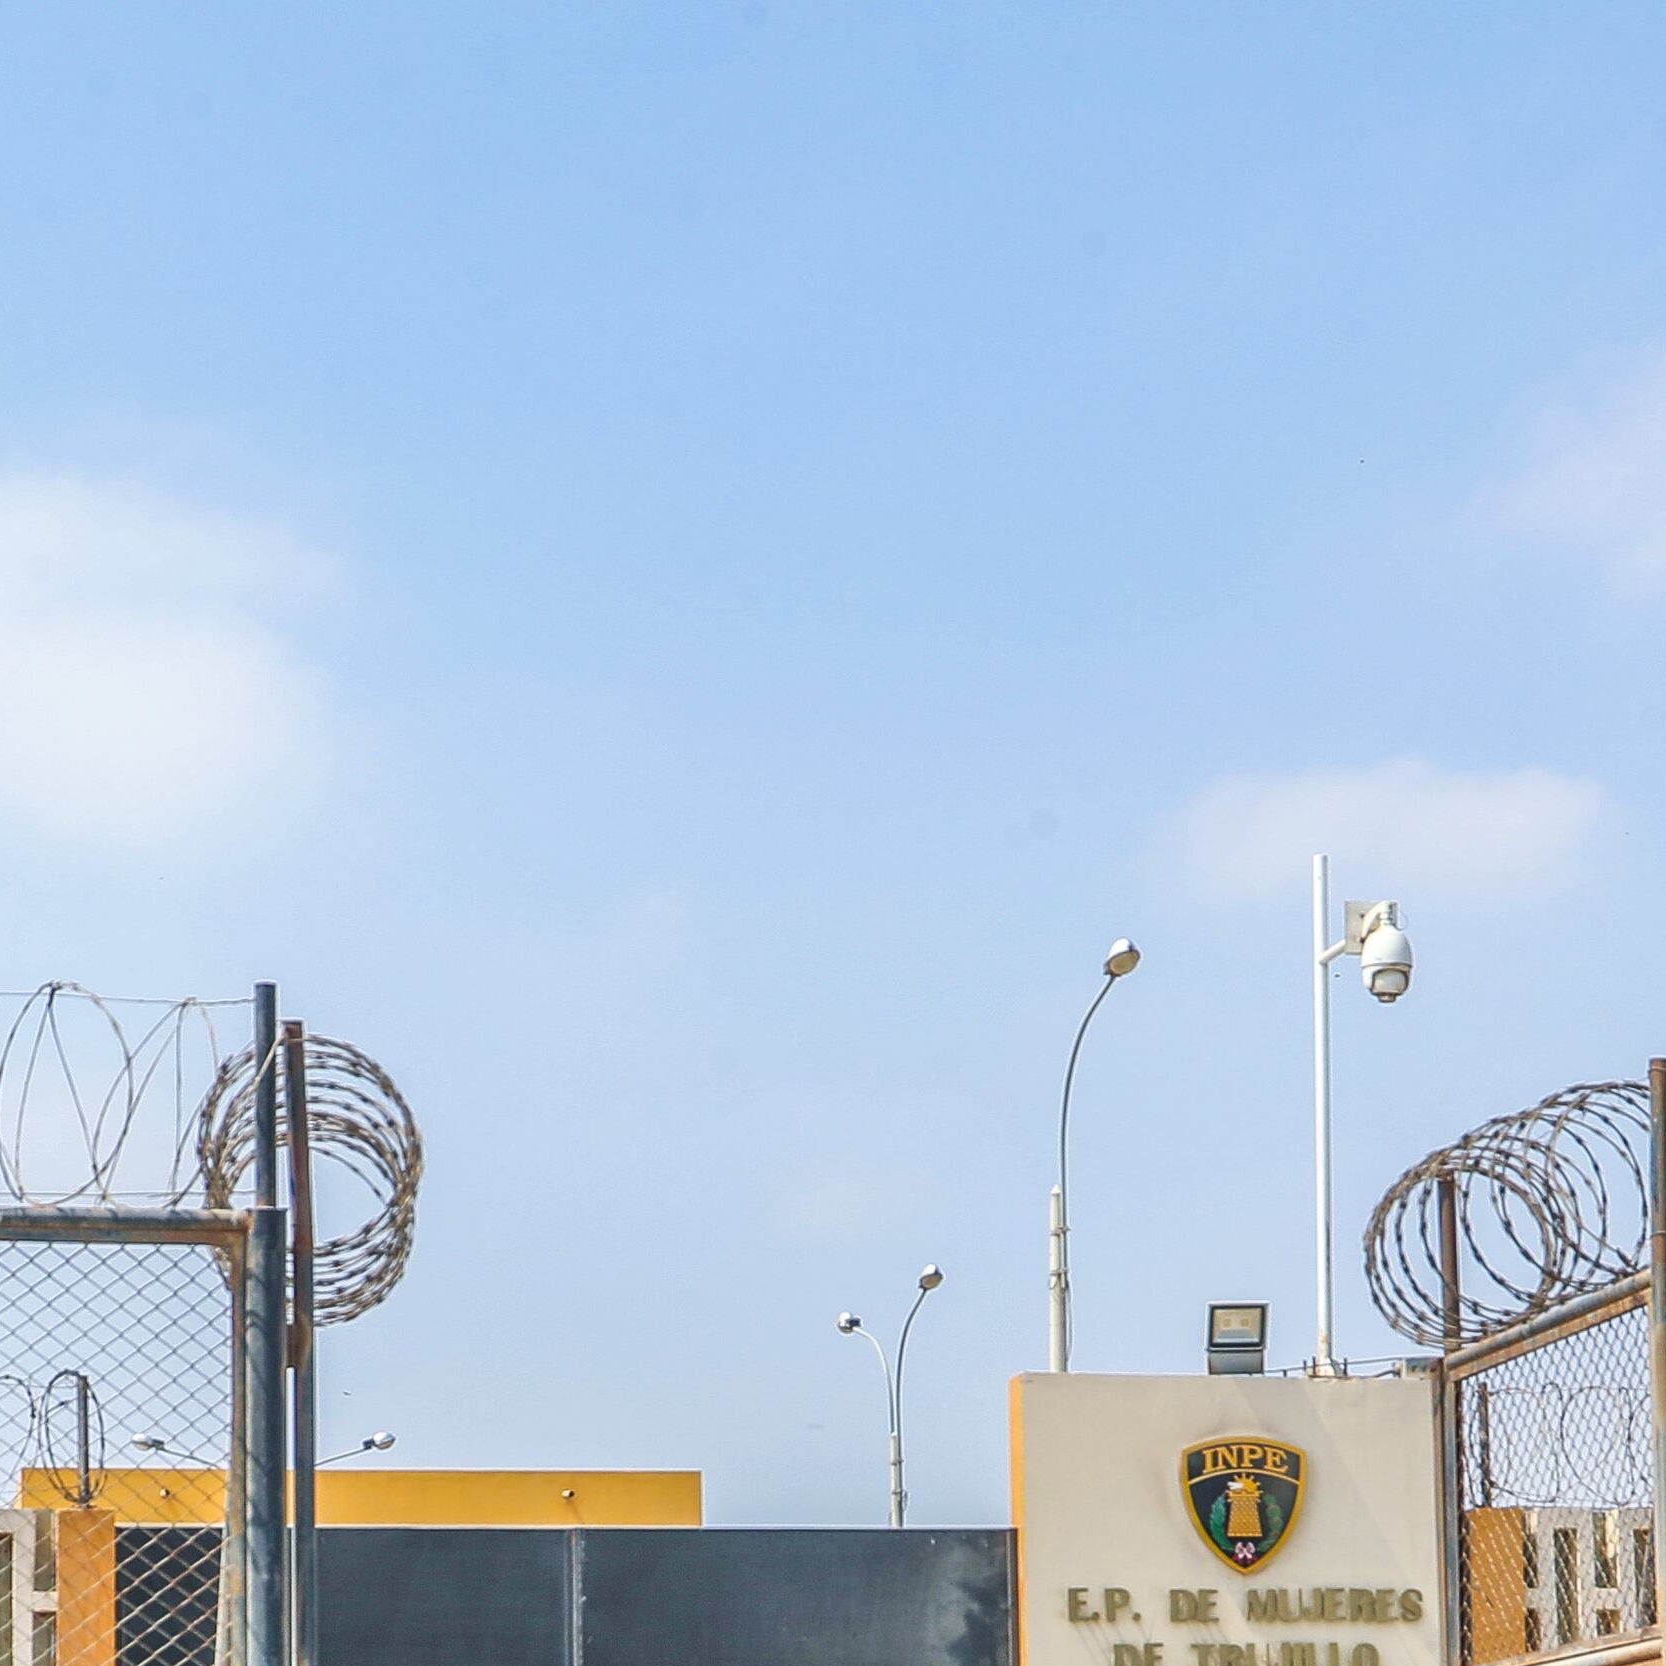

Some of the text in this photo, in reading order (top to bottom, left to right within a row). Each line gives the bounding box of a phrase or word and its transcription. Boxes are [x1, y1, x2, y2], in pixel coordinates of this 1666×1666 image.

[1202, 1444, 1290, 1475] INPE
[1067, 1587, 1424, 1623] E.P. DE MUJERES
